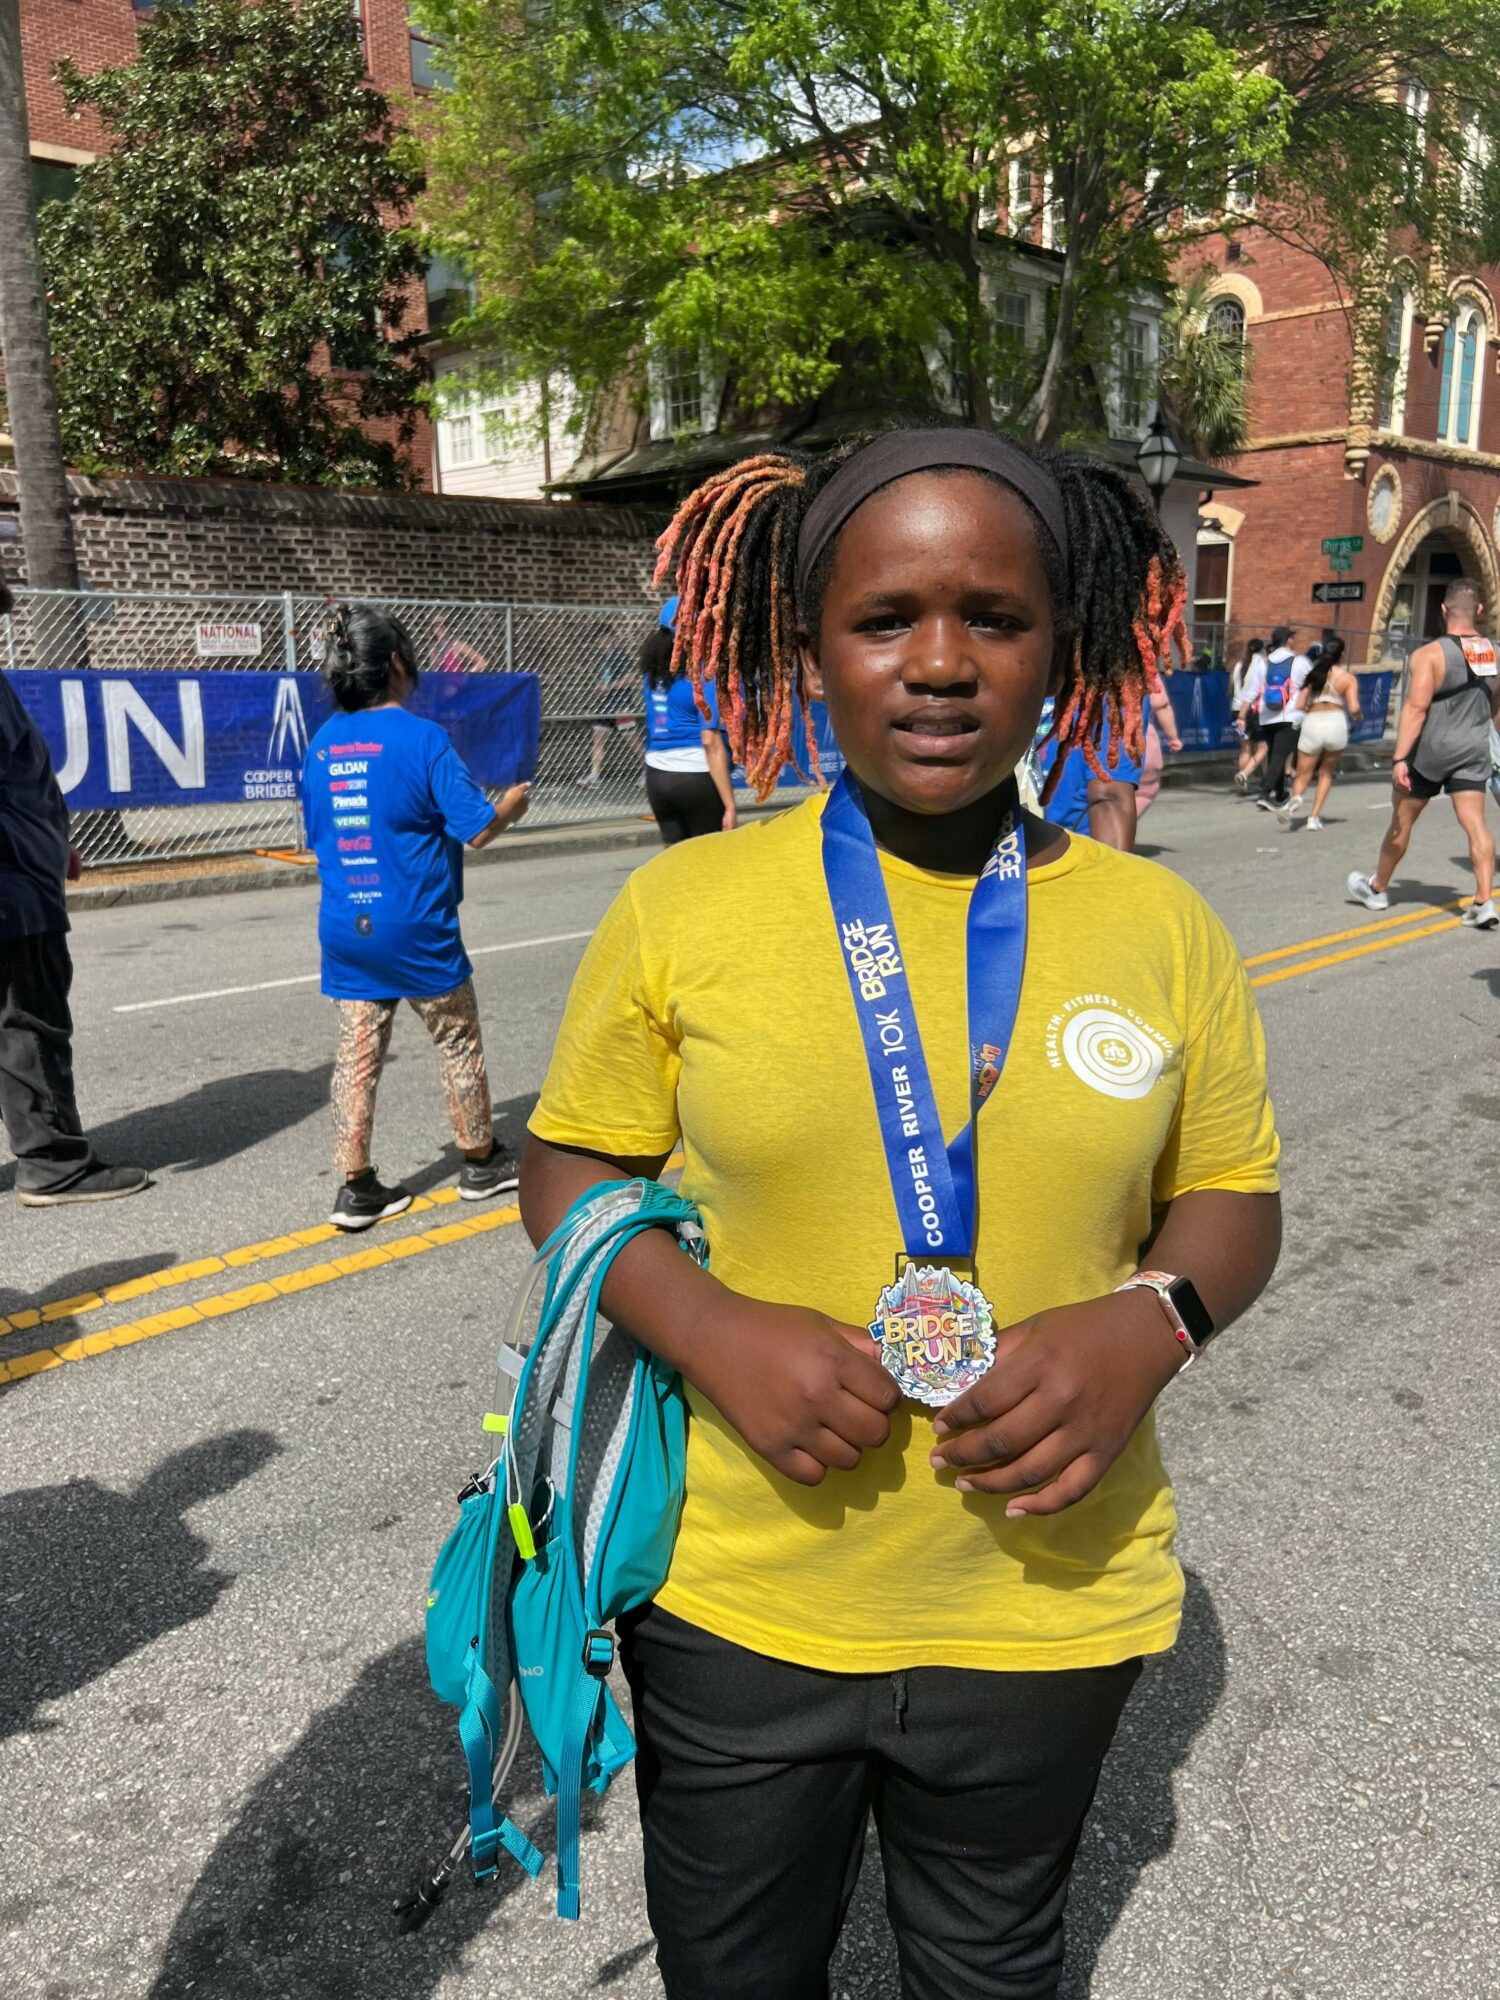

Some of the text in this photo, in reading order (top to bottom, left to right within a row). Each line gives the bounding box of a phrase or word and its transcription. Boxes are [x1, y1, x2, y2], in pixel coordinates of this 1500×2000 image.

[200, 625, 257, 639] NATIONAL
[244, 769, 293, 783] COOPER
[328, 761, 368, 776] GILDAN
[245, 782, 297, 799] BRIDGE
[337, 816, 367, 826] VERDE
[842, 918, 887, 1001] BRIDGE
[866, 923, 903, 979] RUN
[875, 1008, 943, 1247] COOPER RIVER 10K
[883, 1311, 974, 1343] BRIDGE
[905, 1337, 962, 1367] RUN
